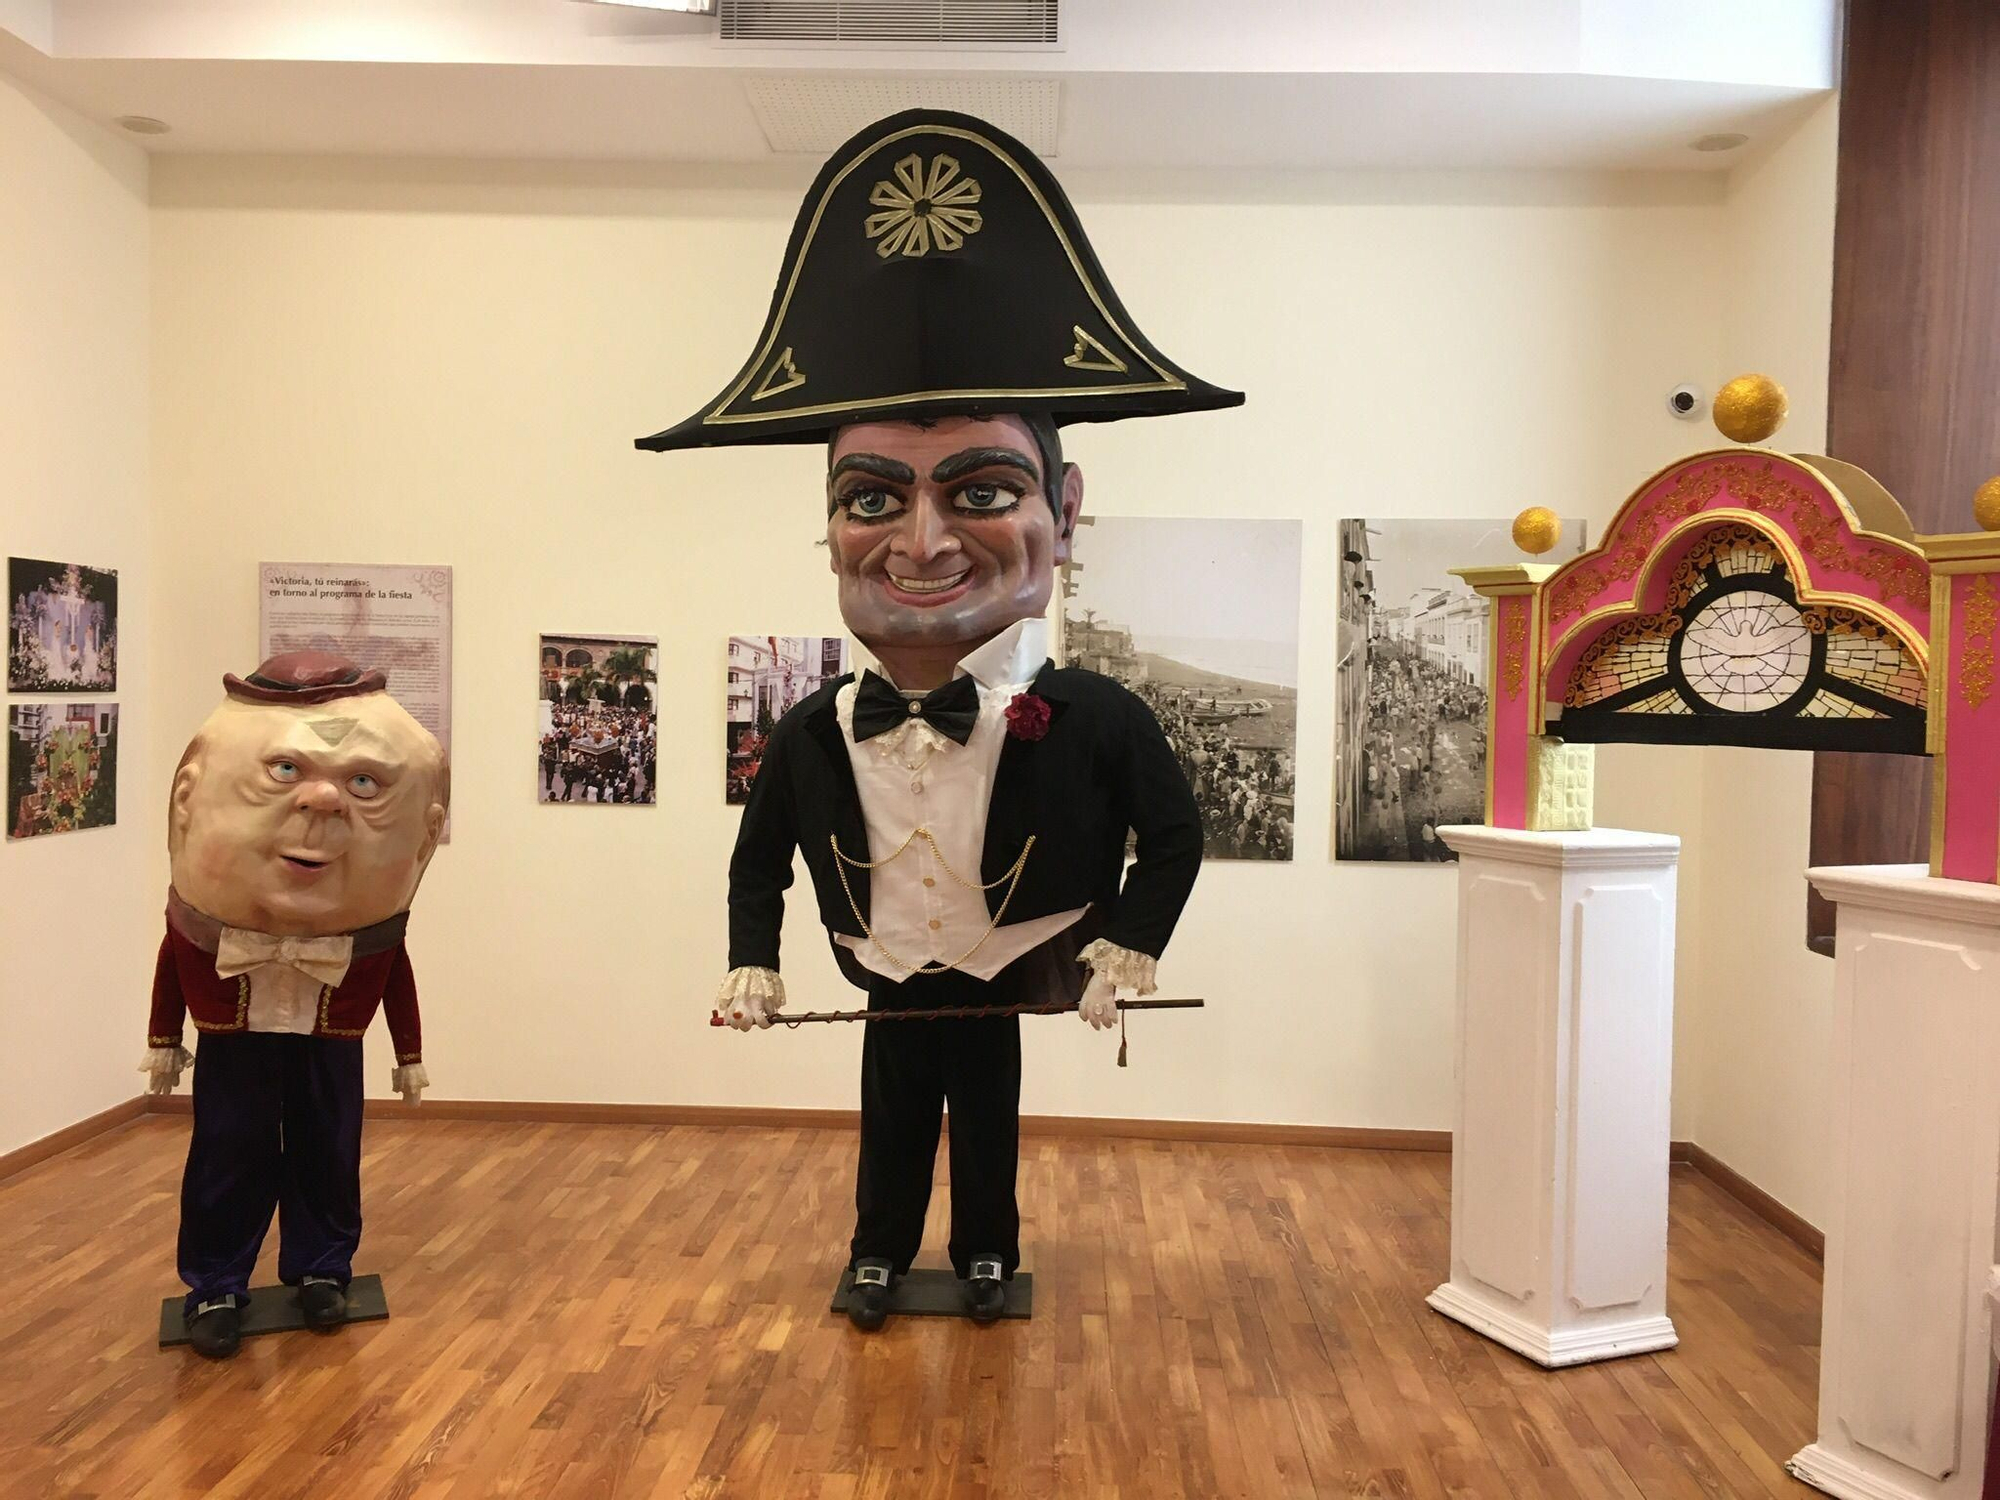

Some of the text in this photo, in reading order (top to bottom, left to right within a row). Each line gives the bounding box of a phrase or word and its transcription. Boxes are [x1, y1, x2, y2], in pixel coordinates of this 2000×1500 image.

[269, 588, 413, 600] en torno al programa de la fiesta
